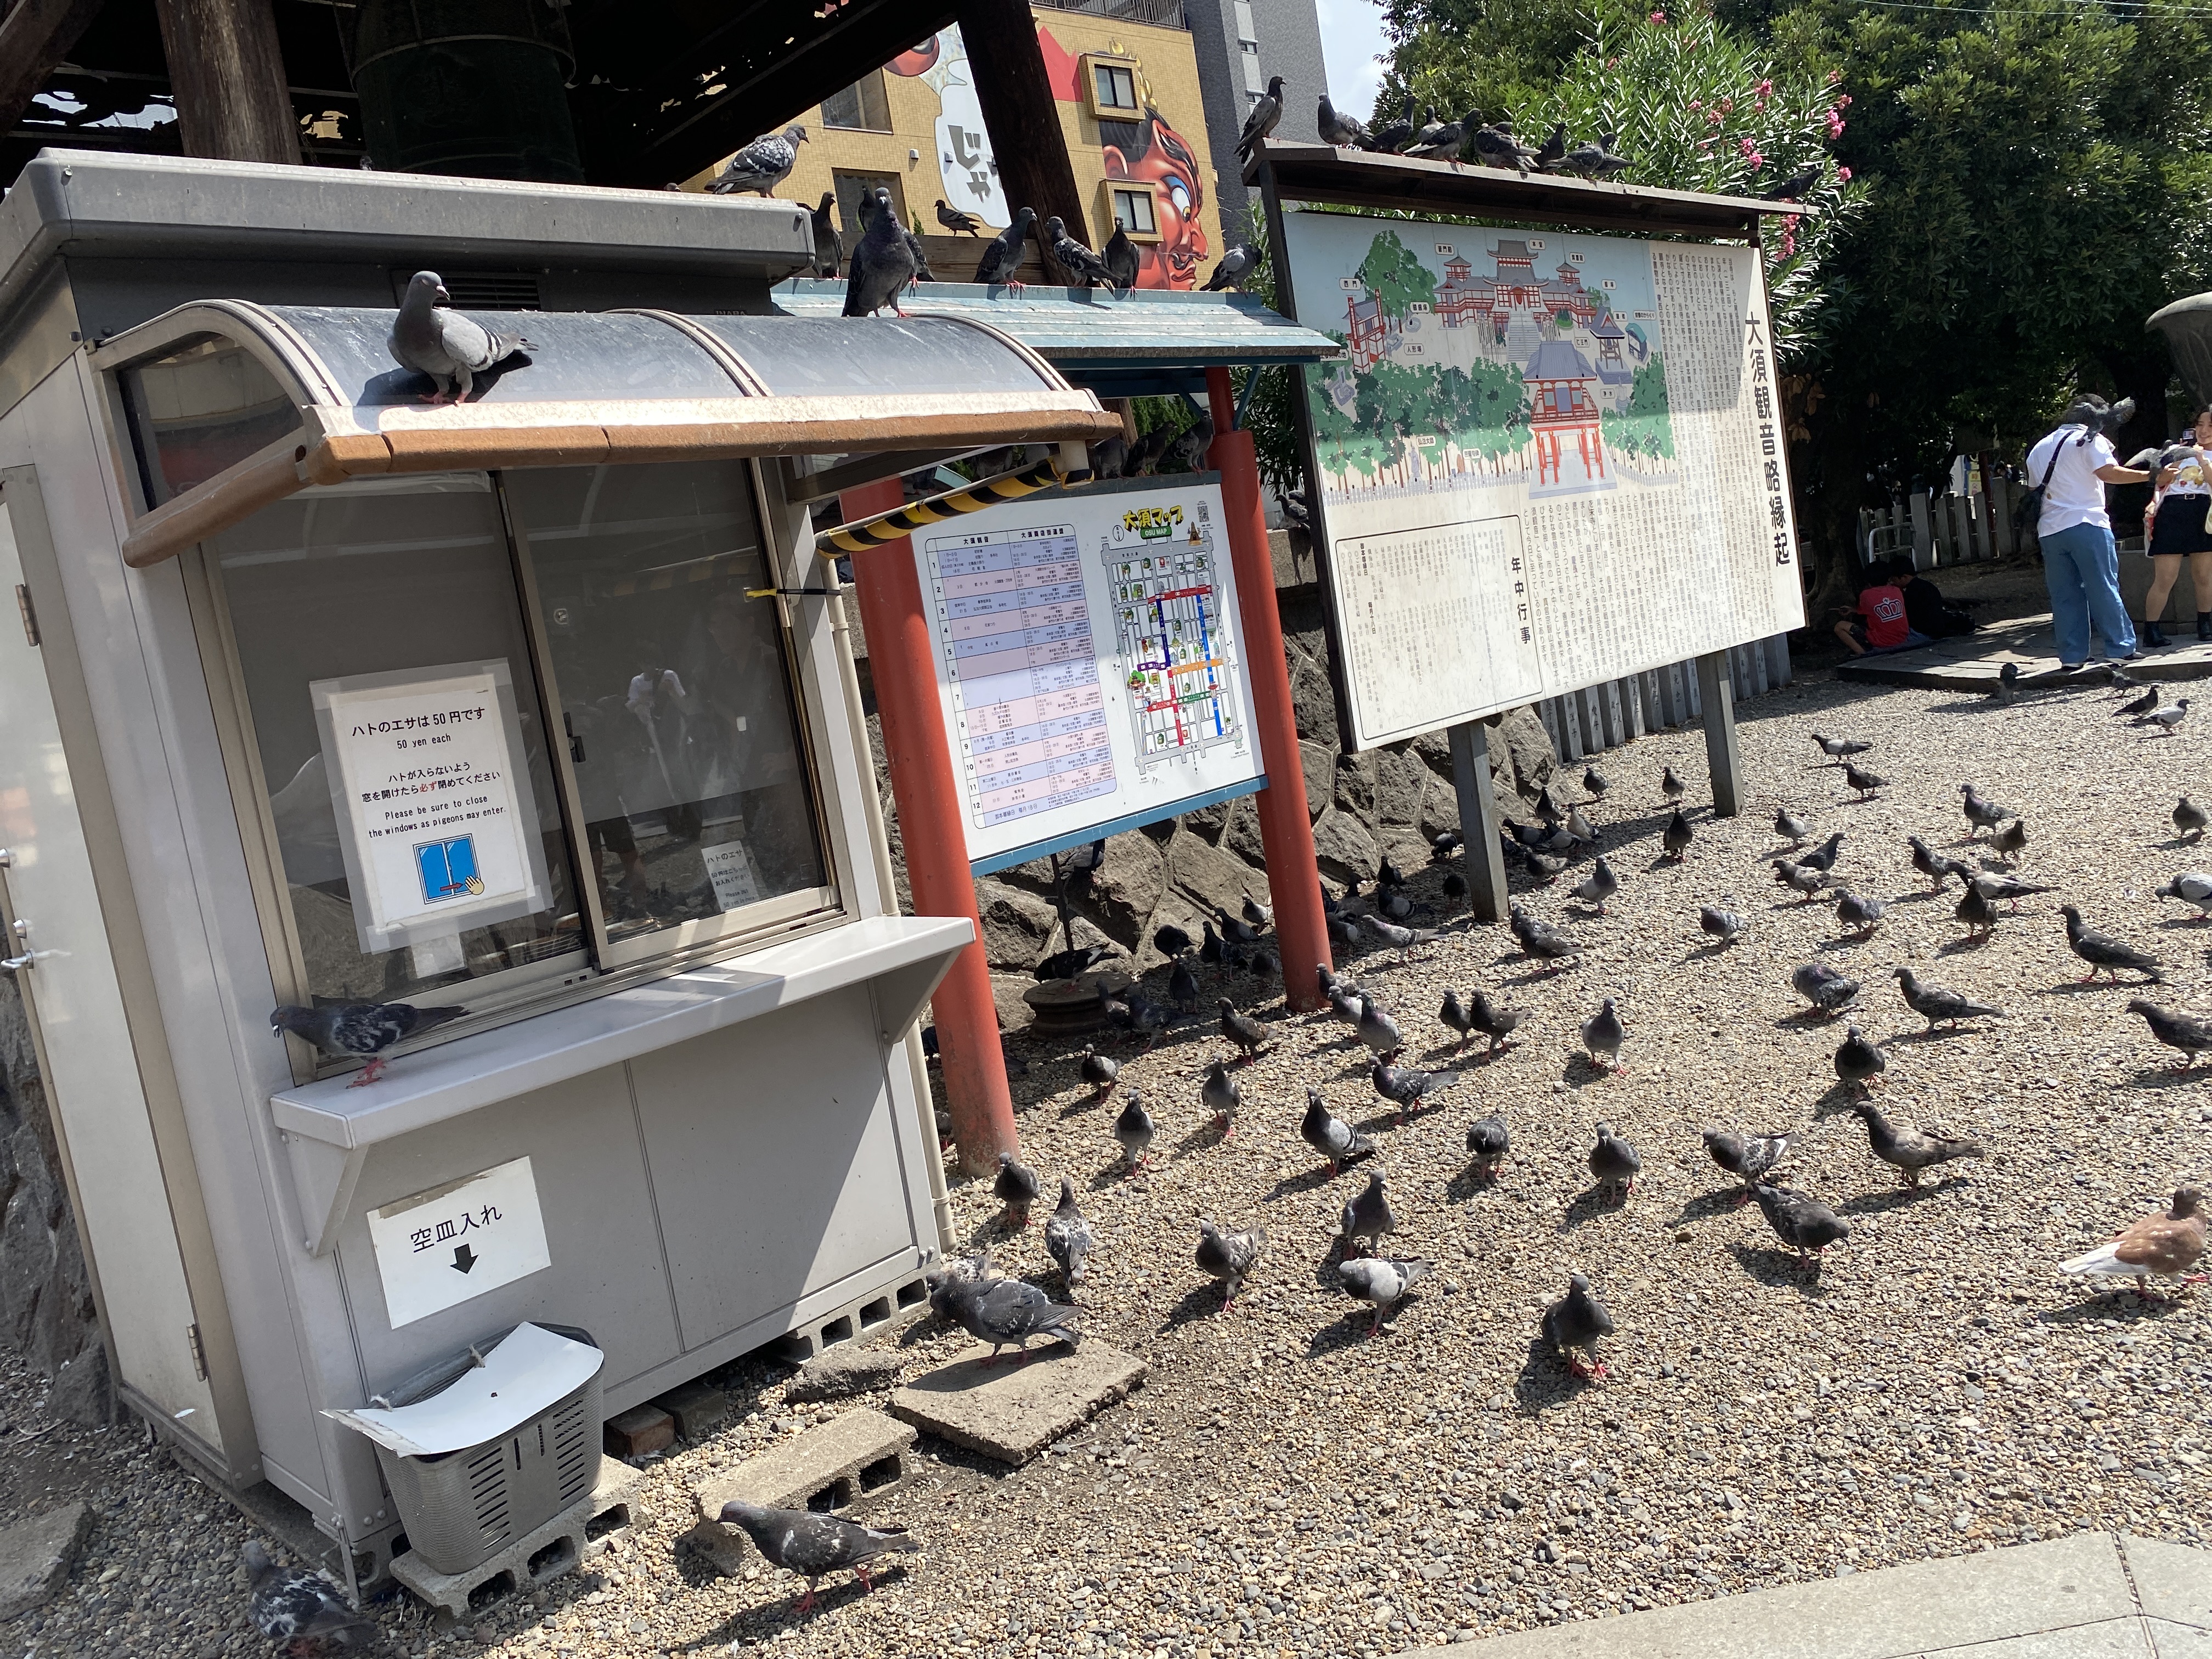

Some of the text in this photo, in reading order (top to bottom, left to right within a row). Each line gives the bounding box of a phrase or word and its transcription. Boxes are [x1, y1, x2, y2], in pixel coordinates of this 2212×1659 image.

[1743, 310, 1791, 567] 大須観音略縁起
[1123, 505, 1184, 532] 大須マップ
[962, 535, 989, 545] 大須観音
[1510, 556, 1531, 645] 年中行事
[397, 733, 451, 749] 50 yen each
[388, 761, 470, 783] ハトが入らないよう
[362, 771, 500, 803] 窓を開けたら必ず閉めてください
[385, 810, 413, 820] Please
[417, 806, 427, 815] be
[431, 803, 449, 812] sure
[466, 795, 488, 805] close
[369, 830, 382, 838] the
[385, 823, 417, 835] windows
[421, 820, 430, 828] as
[433, 814, 464, 826] pigeons
[707, 849, 743, 864] ハトのエサ
[410, 1205, 503, 1253] 空皿入れ
